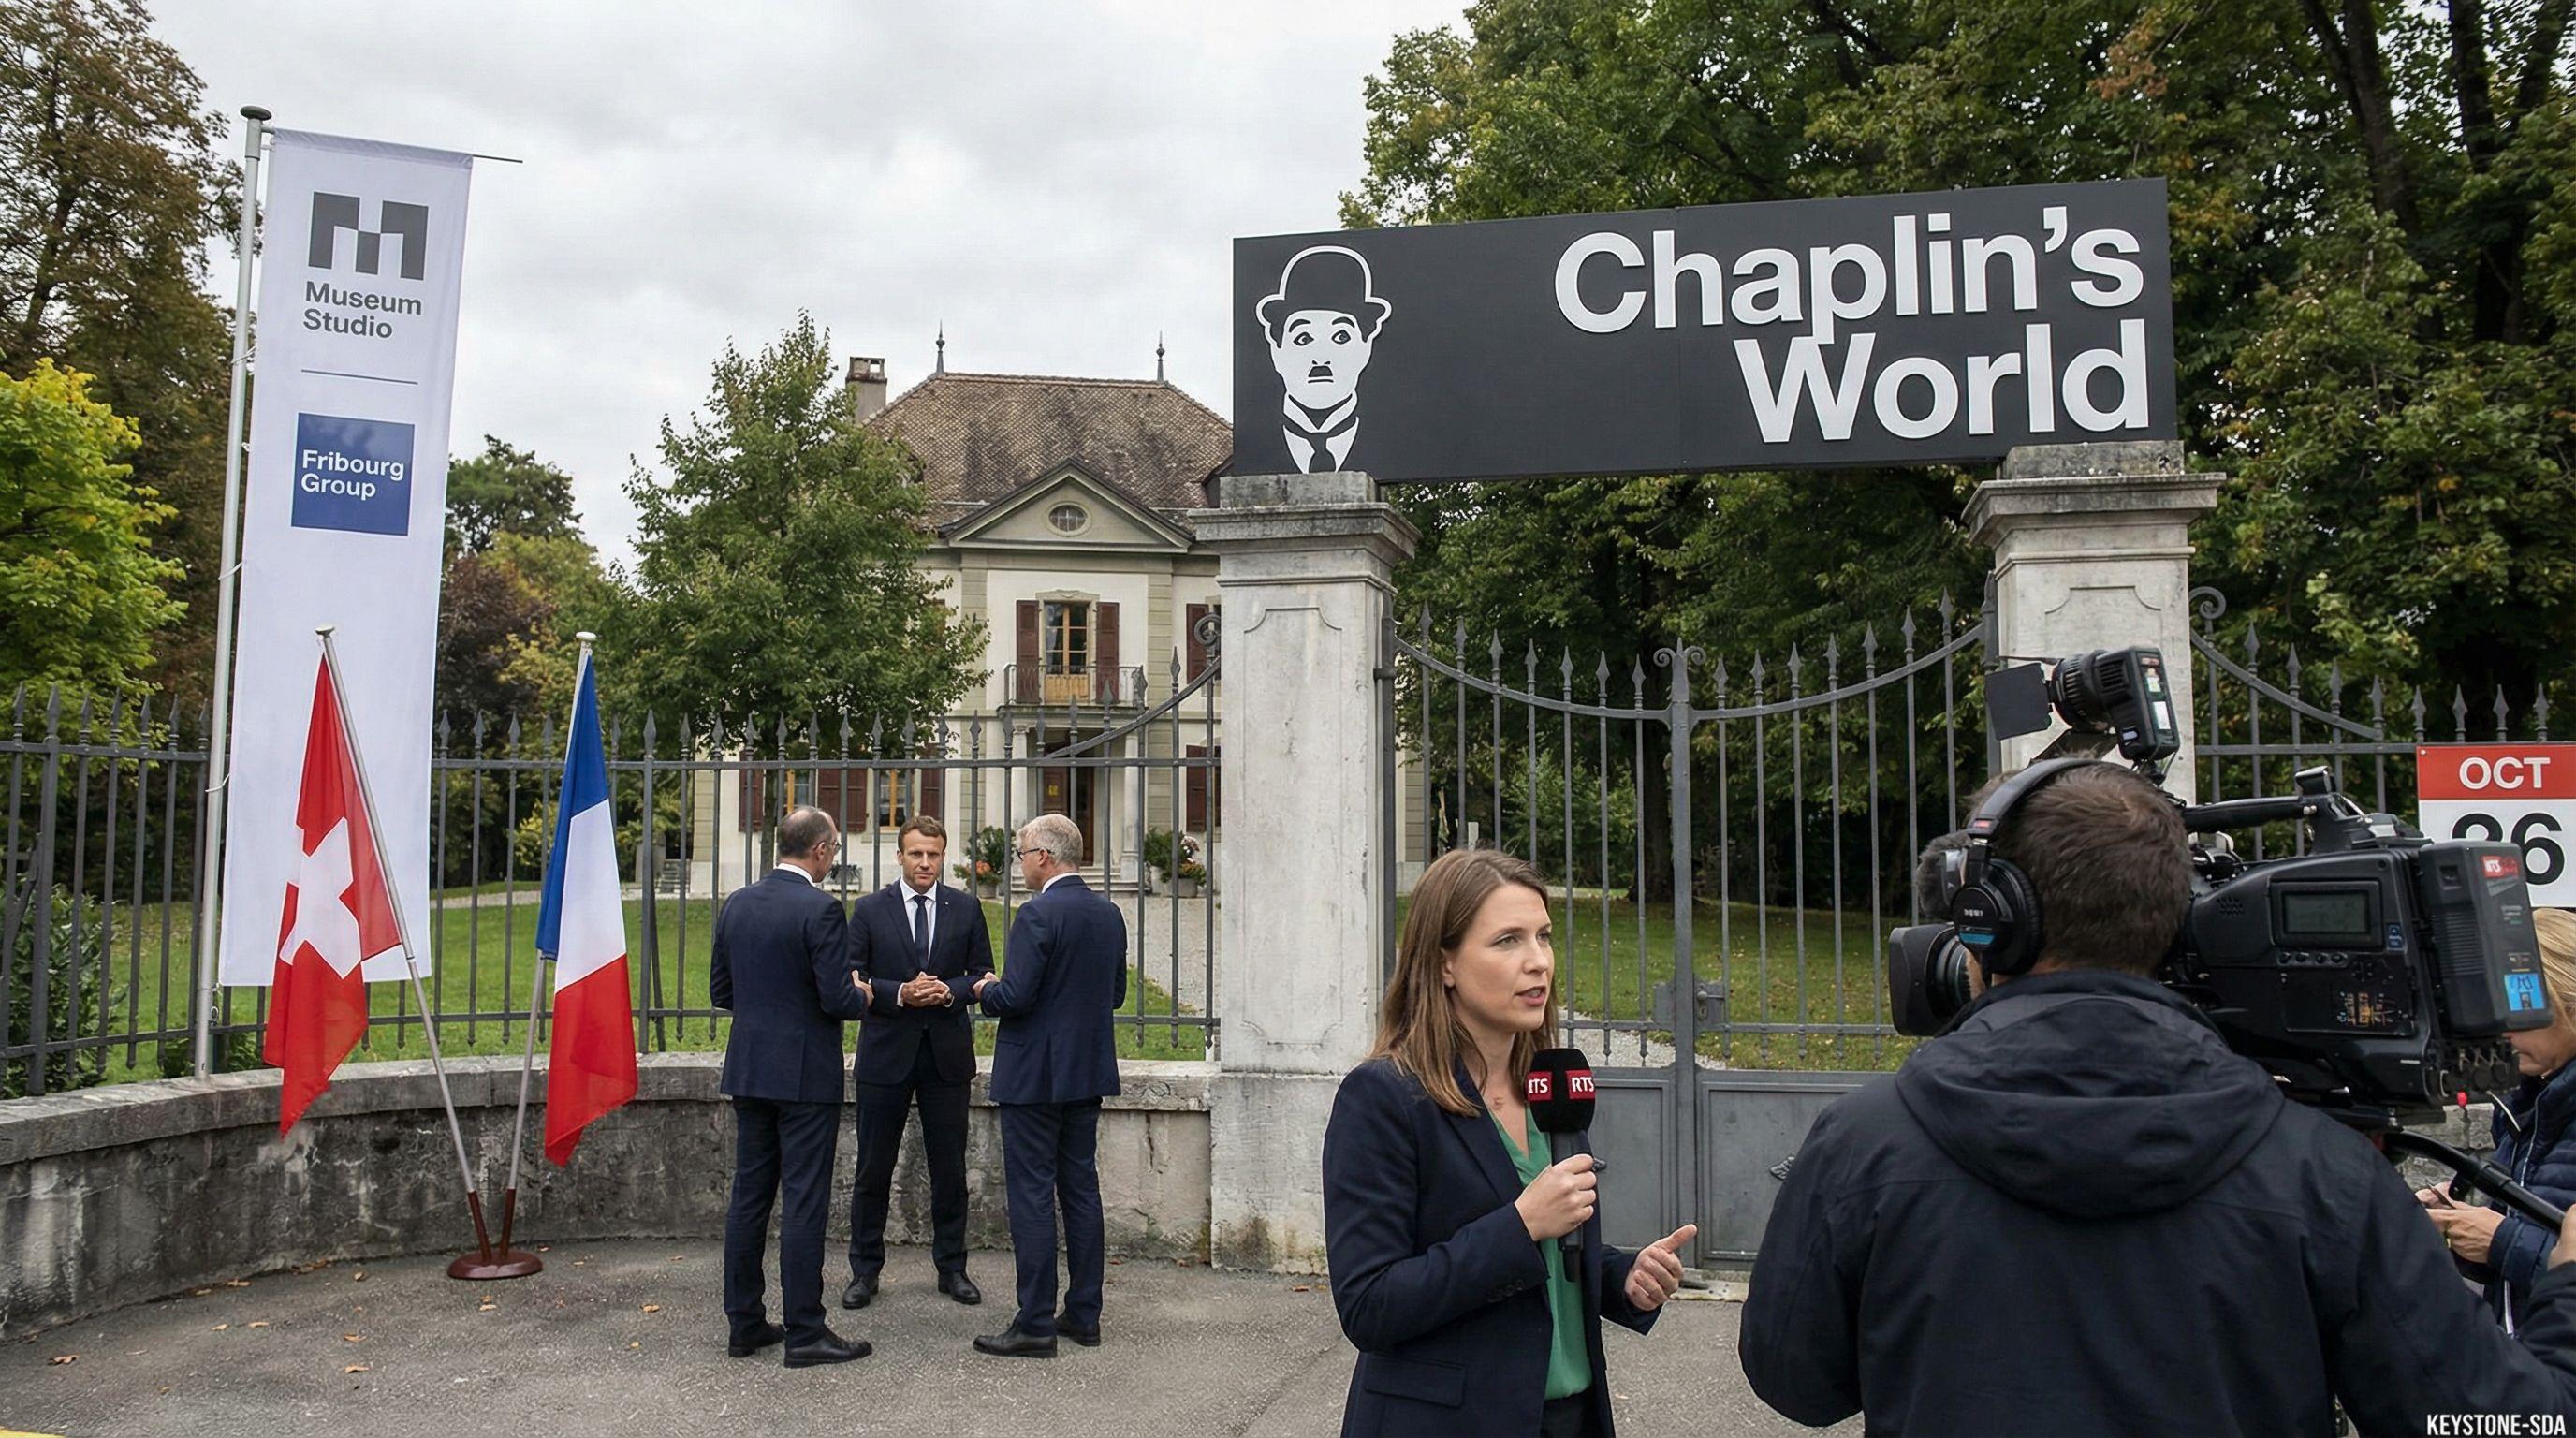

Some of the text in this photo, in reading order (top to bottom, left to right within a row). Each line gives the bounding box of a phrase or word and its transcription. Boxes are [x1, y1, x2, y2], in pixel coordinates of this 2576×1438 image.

[1555, 206, 2144, 345] Chaplin’s
[305, 281, 422, 315] Museum
[303, 308, 393, 338] Studio
[1734, 319, 2149, 443] World
[302, 449, 404, 481] Fribourg
[300, 474, 376, 501] Group
[2459, 756, 2551, 789] OCT
[1572, 1077, 1595, 1092] RTS
